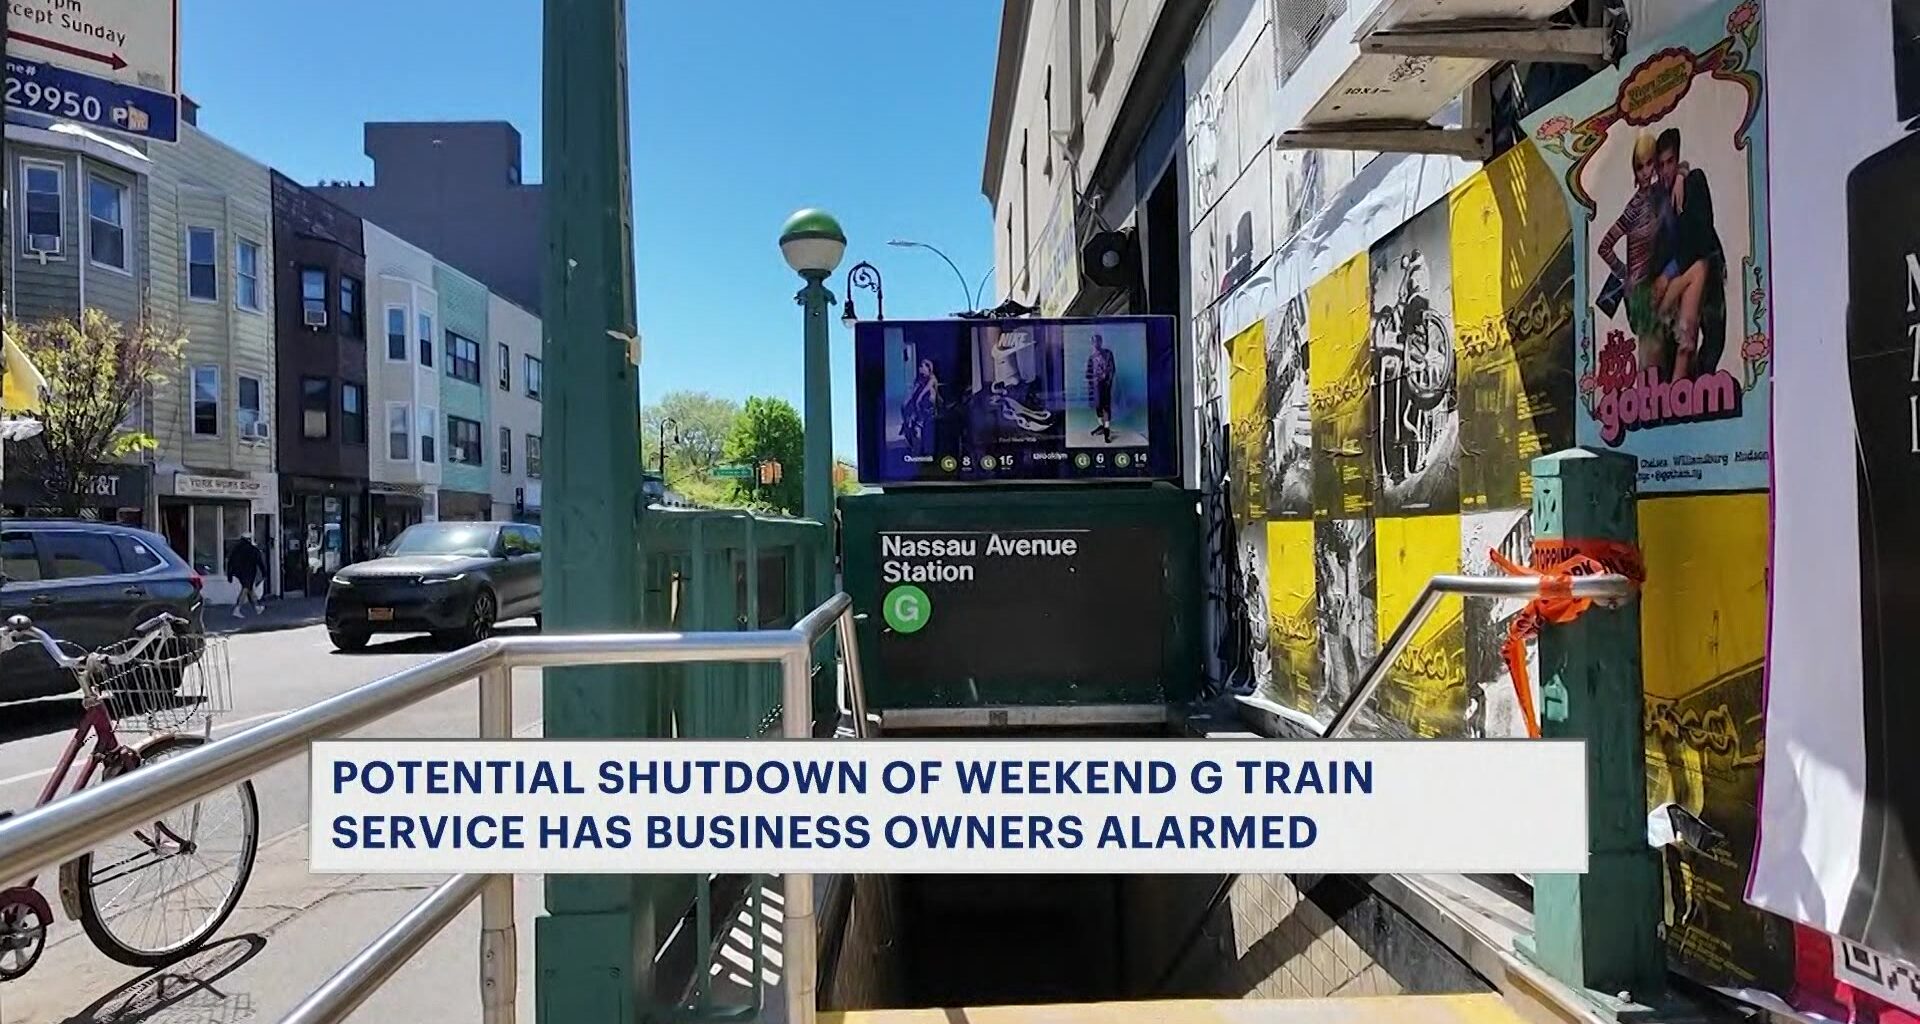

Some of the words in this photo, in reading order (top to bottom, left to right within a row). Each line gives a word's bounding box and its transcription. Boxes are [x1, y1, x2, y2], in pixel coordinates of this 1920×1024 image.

[47, 0, 81, 12] pm
[60, 13, 126, 47] Sunday
[1600, 365, 1741, 446] gotham
[882, 535, 976, 557] Nassau
[985, 534, 1078, 556] Avenue
[883, 560, 974, 583] Station
[895, 595, 919, 622] G
